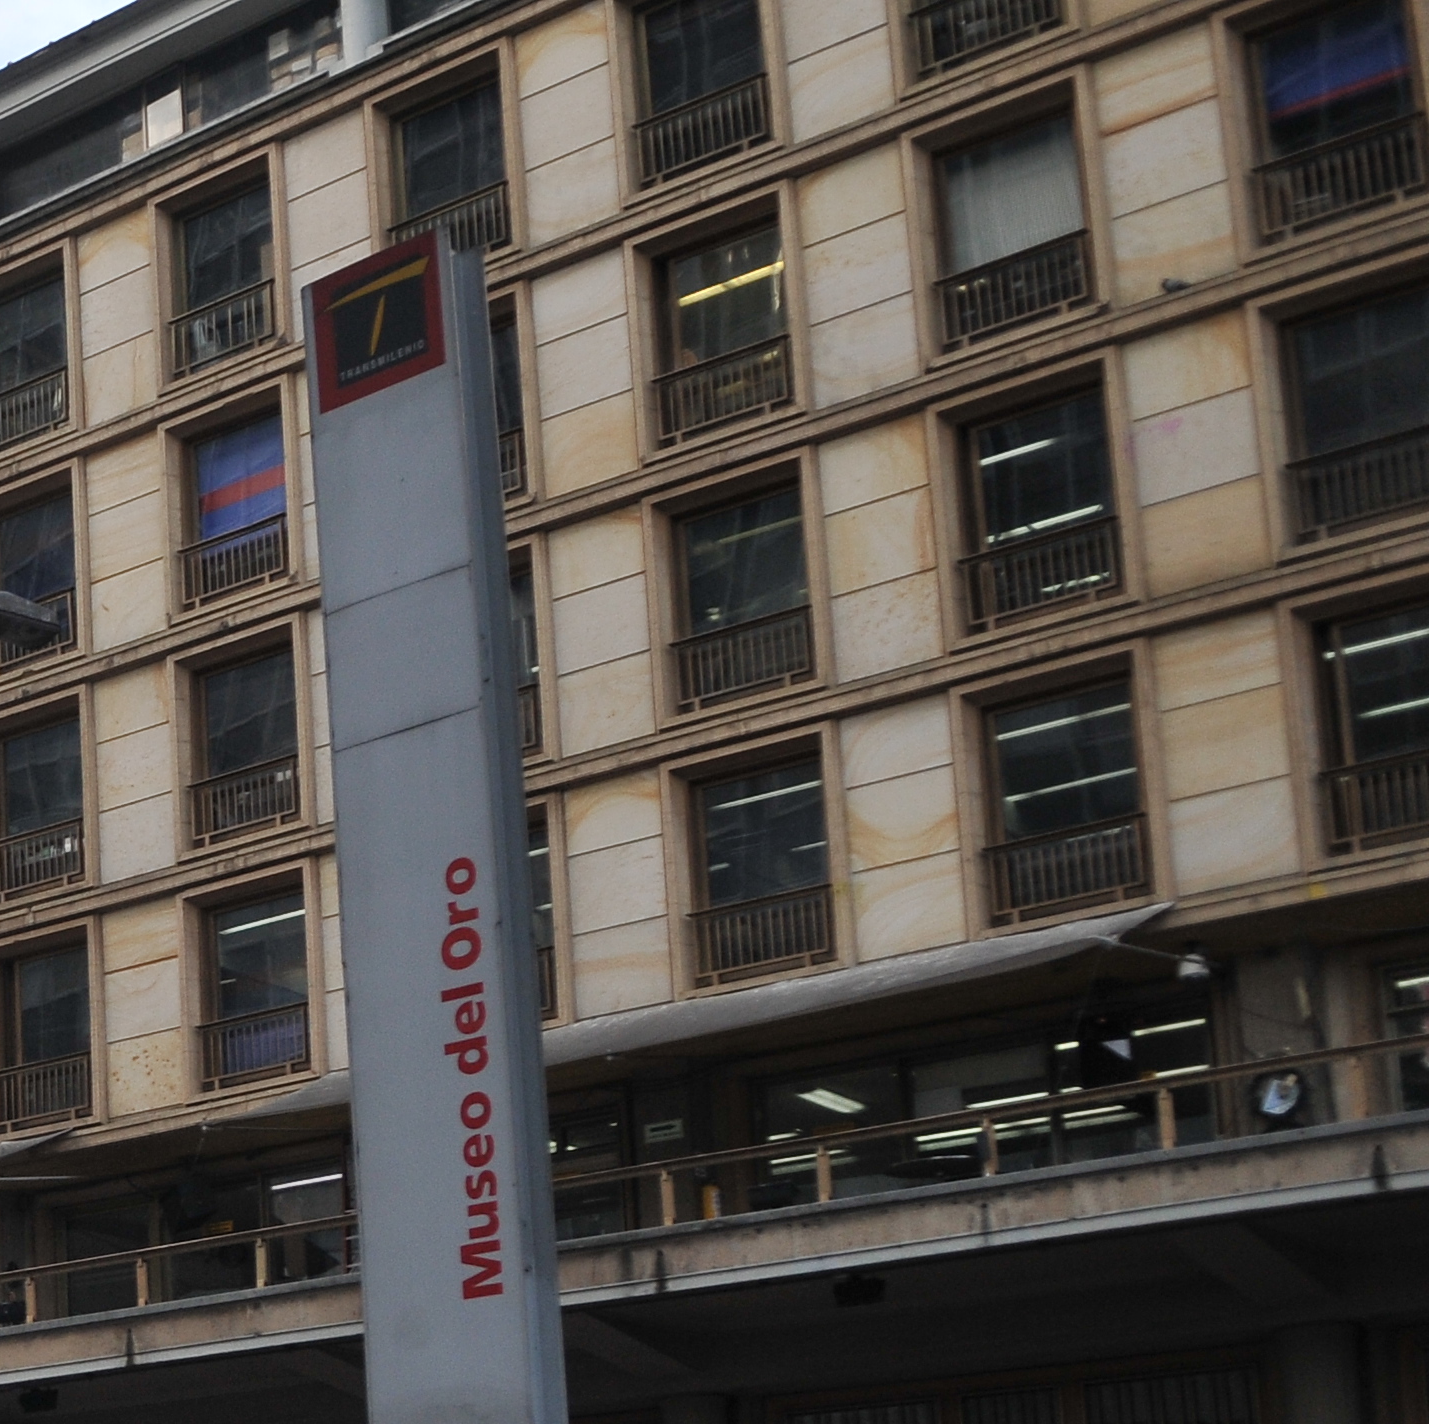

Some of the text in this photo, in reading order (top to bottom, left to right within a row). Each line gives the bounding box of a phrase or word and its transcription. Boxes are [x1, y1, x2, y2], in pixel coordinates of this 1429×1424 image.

[340, 339, 426, 382] TRANSMILENIO
[441, 856, 504, 1300] Museo del Oro
